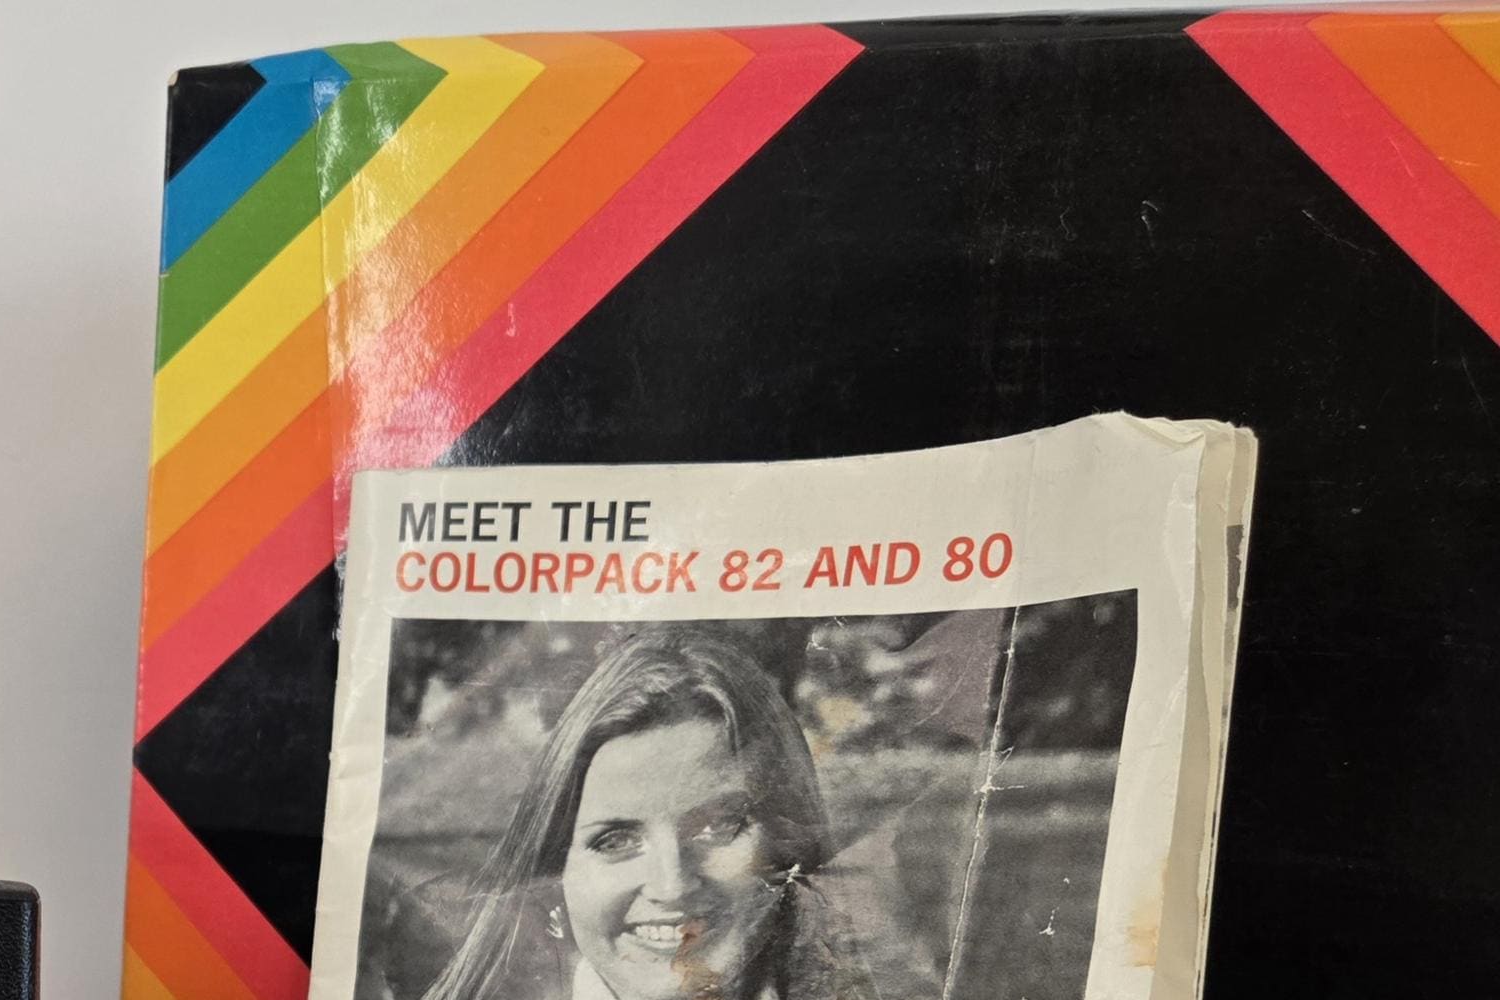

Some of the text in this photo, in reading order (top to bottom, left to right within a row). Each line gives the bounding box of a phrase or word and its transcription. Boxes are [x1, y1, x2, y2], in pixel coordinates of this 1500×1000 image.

[399, 500, 651, 543] MEET THE
[395, 532, 1014, 594] COLORPACK 82 AND 80
